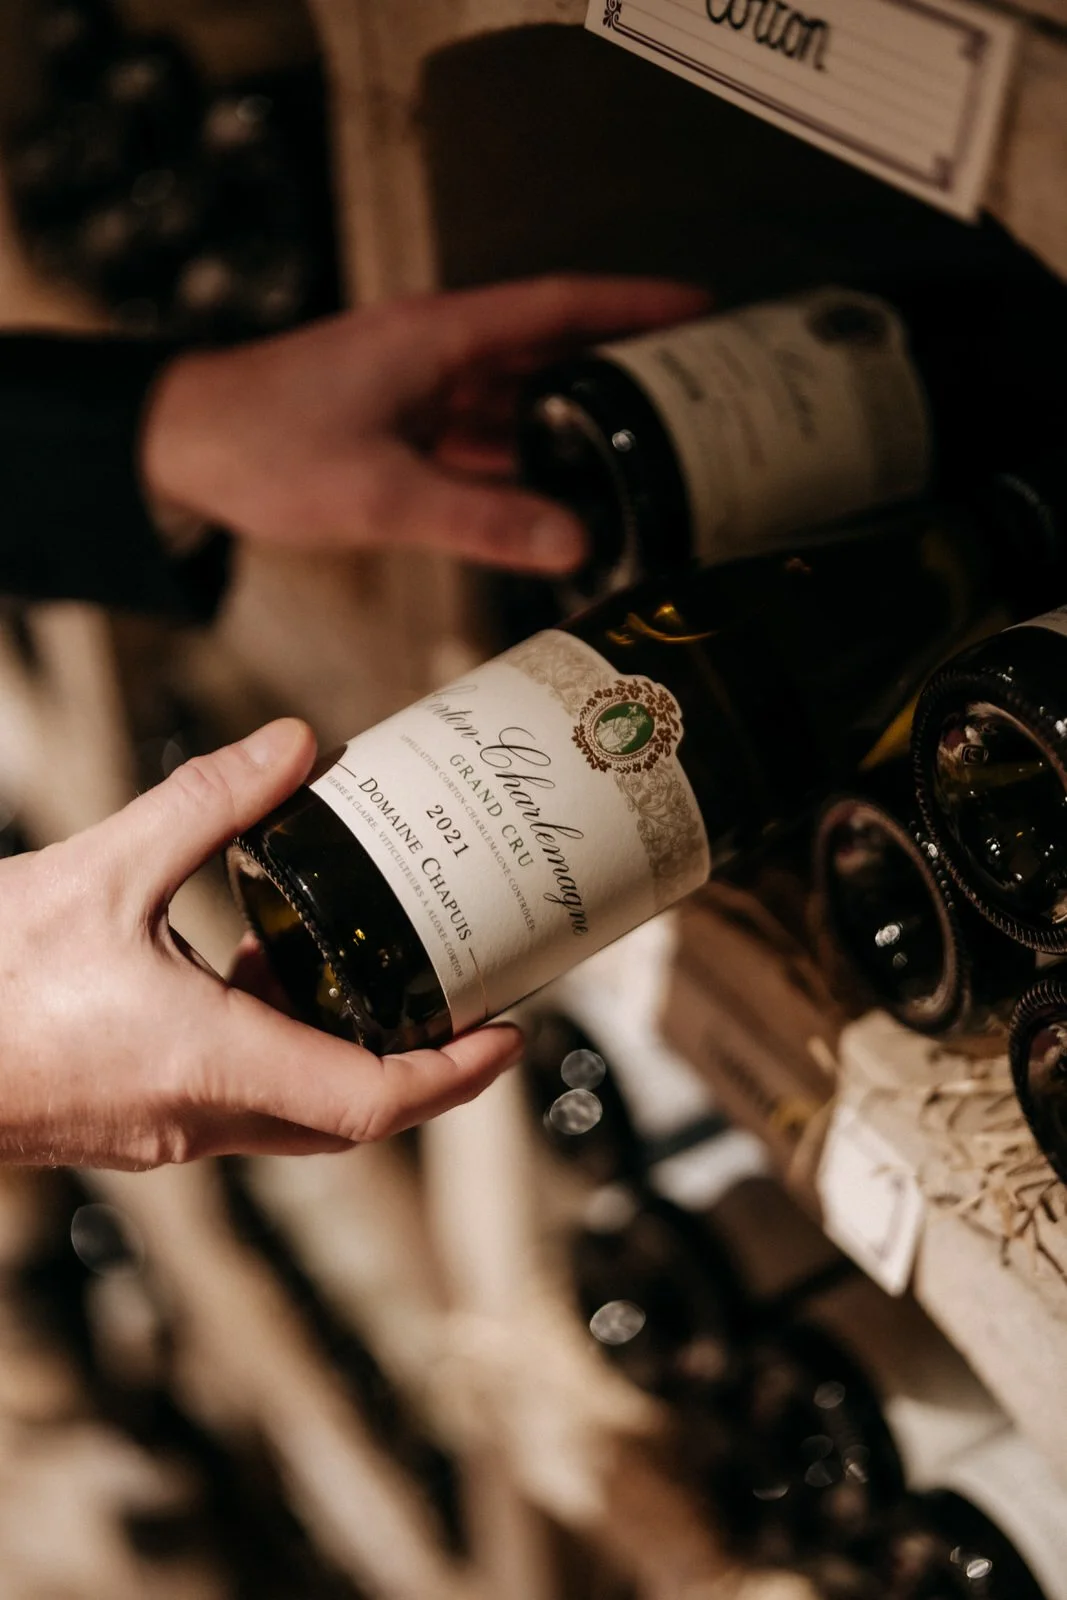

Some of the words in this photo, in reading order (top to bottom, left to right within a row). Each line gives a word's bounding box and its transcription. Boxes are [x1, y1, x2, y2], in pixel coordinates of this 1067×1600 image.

[358, 777, 424, 855] DOMAINE
[421, 857, 472, 942] CHAPUIS
[426, 804, 469, 859] 2021
[450, 753, 503, 818] GRAND
[501, 824, 535, 868] CRU
